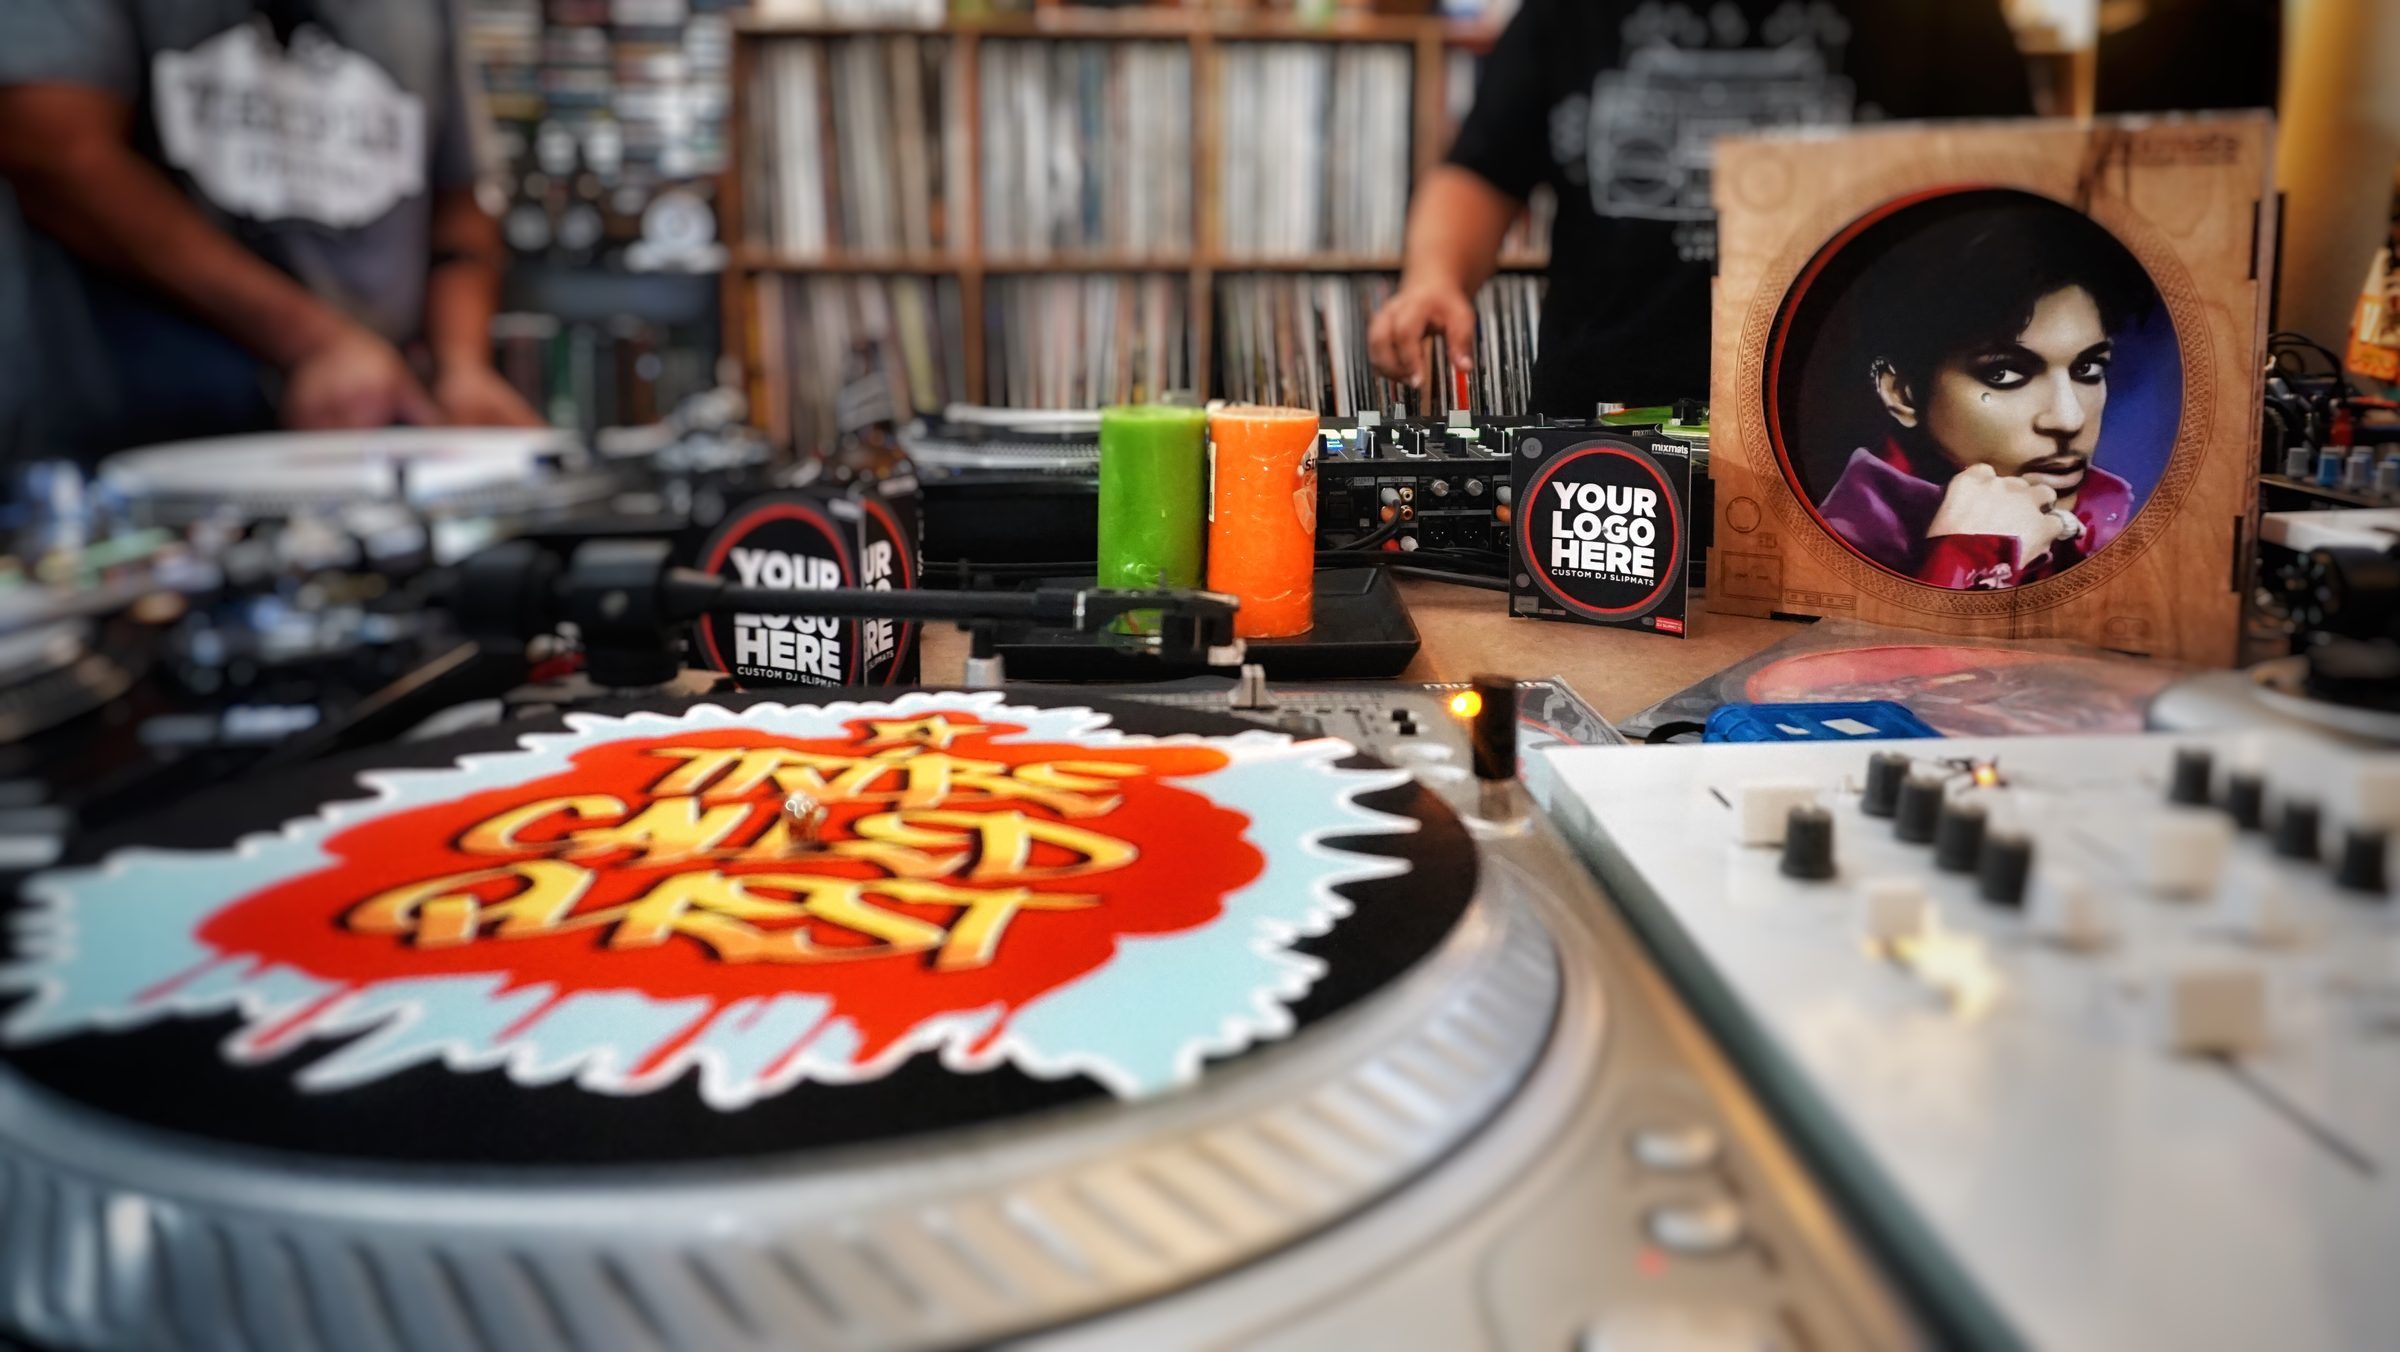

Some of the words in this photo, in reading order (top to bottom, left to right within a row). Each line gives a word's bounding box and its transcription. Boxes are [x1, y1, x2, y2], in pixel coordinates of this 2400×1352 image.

[1651, 443, 1689, 455] mixmats
[1552, 481, 1657, 518] YOUR
[1552, 510, 1656, 547] LOGO
[1551, 538, 1655, 578] HERE
[1551, 568, 1592, 579] CUSTOM
[1595, 571, 1607, 580] DJ
[1610, 573, 1655, 587] SLIPMATS
[735, 626, 842, 681] HERE
[736, 665, 783, 680] CUSTOM
[785, 672, 798, 682] DJ
[347, 857, 1103, 970] QUEST
